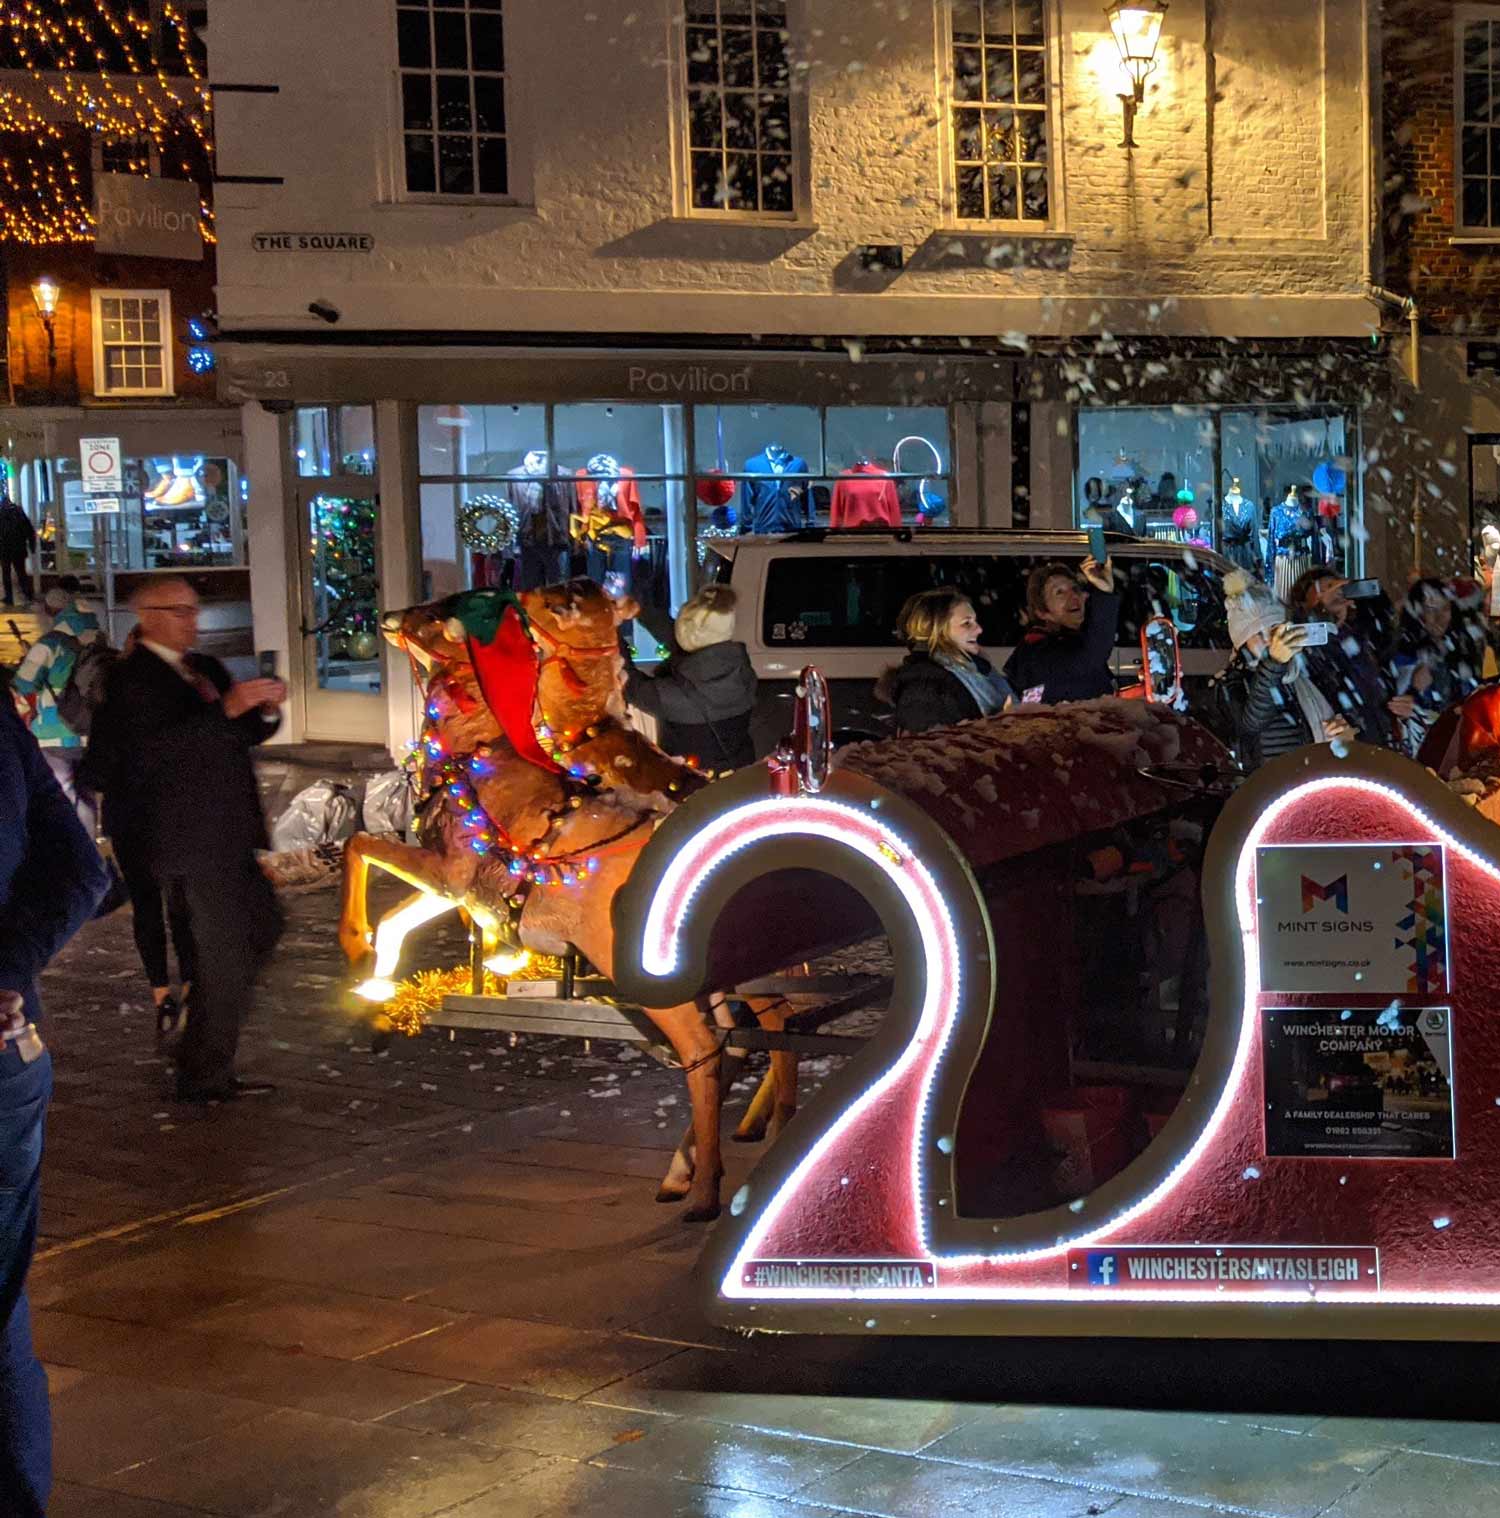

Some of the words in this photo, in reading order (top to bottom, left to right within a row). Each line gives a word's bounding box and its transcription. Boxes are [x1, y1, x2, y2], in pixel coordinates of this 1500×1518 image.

[101, 199, 197, 232] Pavilion
[257, 236, 291, 248] THE
[299, 236, 369, 249] SQUARE
[629, 366, 750, 391] Pavilion
[1278, 921, 1318, 932] MINT
[1322, 921, 1374, 932] SIGNS
[1282, 1025, 1365, 1036] WINCHESTER
[1368, 1025, 1415, 1036] MOTOR
[1319, 1040, 1383, 1051] COMPANY
[1284, 1111, 1292, 1119] A
[1293, 1111, 1323, 1119] FAMILY
[1324, 1111, 1375, 1119] DEALERSHIP
[1377, 1111, 1399, 1119] THAT
[1128, 1257, 1358, 1280] WINCHESTERSANTASLEIGH
[755, 1265, 923, 1287] #WINCHESTERSANTA
